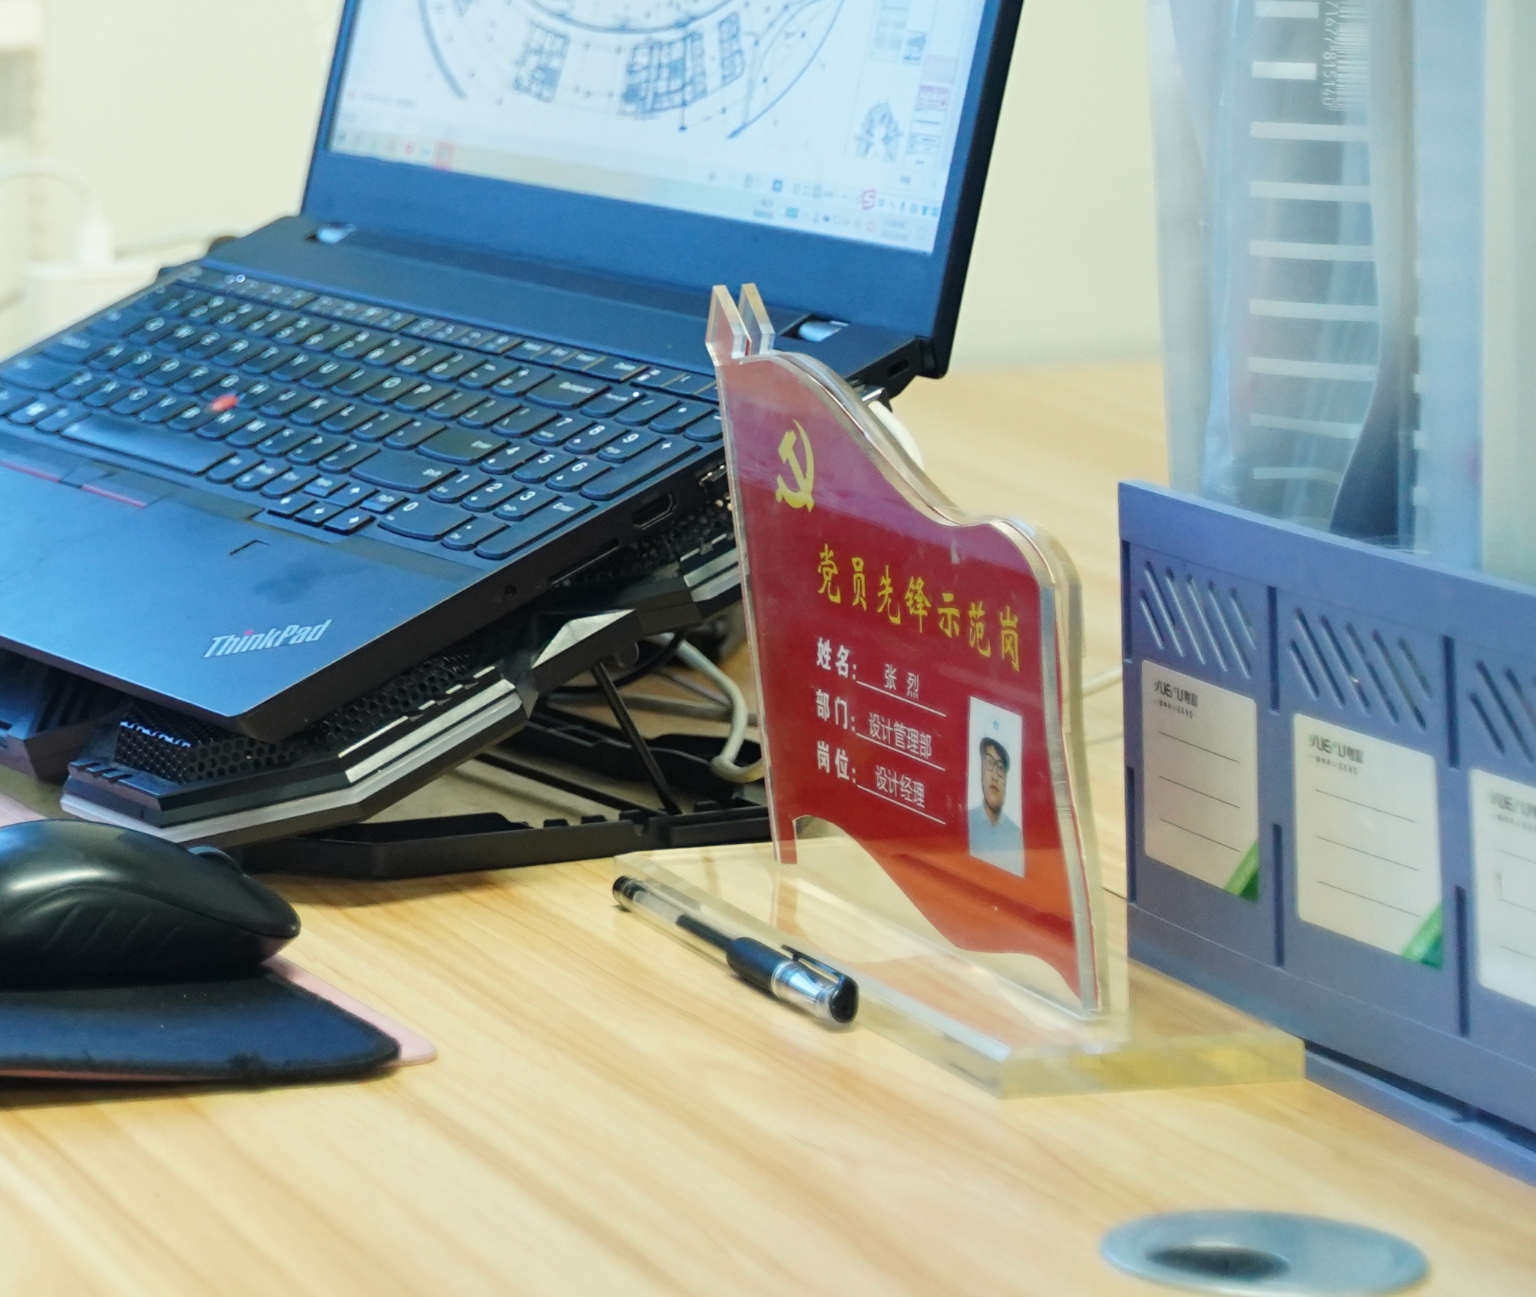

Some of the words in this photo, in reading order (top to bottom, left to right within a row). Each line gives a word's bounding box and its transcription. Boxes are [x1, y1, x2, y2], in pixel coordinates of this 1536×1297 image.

[1322, 51, 1338, 106] 815140
[556, 417, 573, 427] 7
[588, 425, 606, 436] 8
[622, 433, 640, 444] 9
[506, 446, 521, 455] 4
[537, 453, 555, 464] 5
[571, 461, 588, 472] 6
[402, 501, 419, 512] 0
[455, 474, 470, 484] 1
[485, 482, 503, 493] 2
[519, 491, 536, 501] 3
[817, 543, 1021, 673] 党员先锋示范岗
[203, 618, 333, 658] ThinkPad
[815, 636, 858, 681] 姓名：
[814, 688, 856, 733] 部门：
[868, 711, 933, 760] 设计管理部
[816, 740, 857, 784] 岗位：
[874, 764, 926, 809] 设计经理
